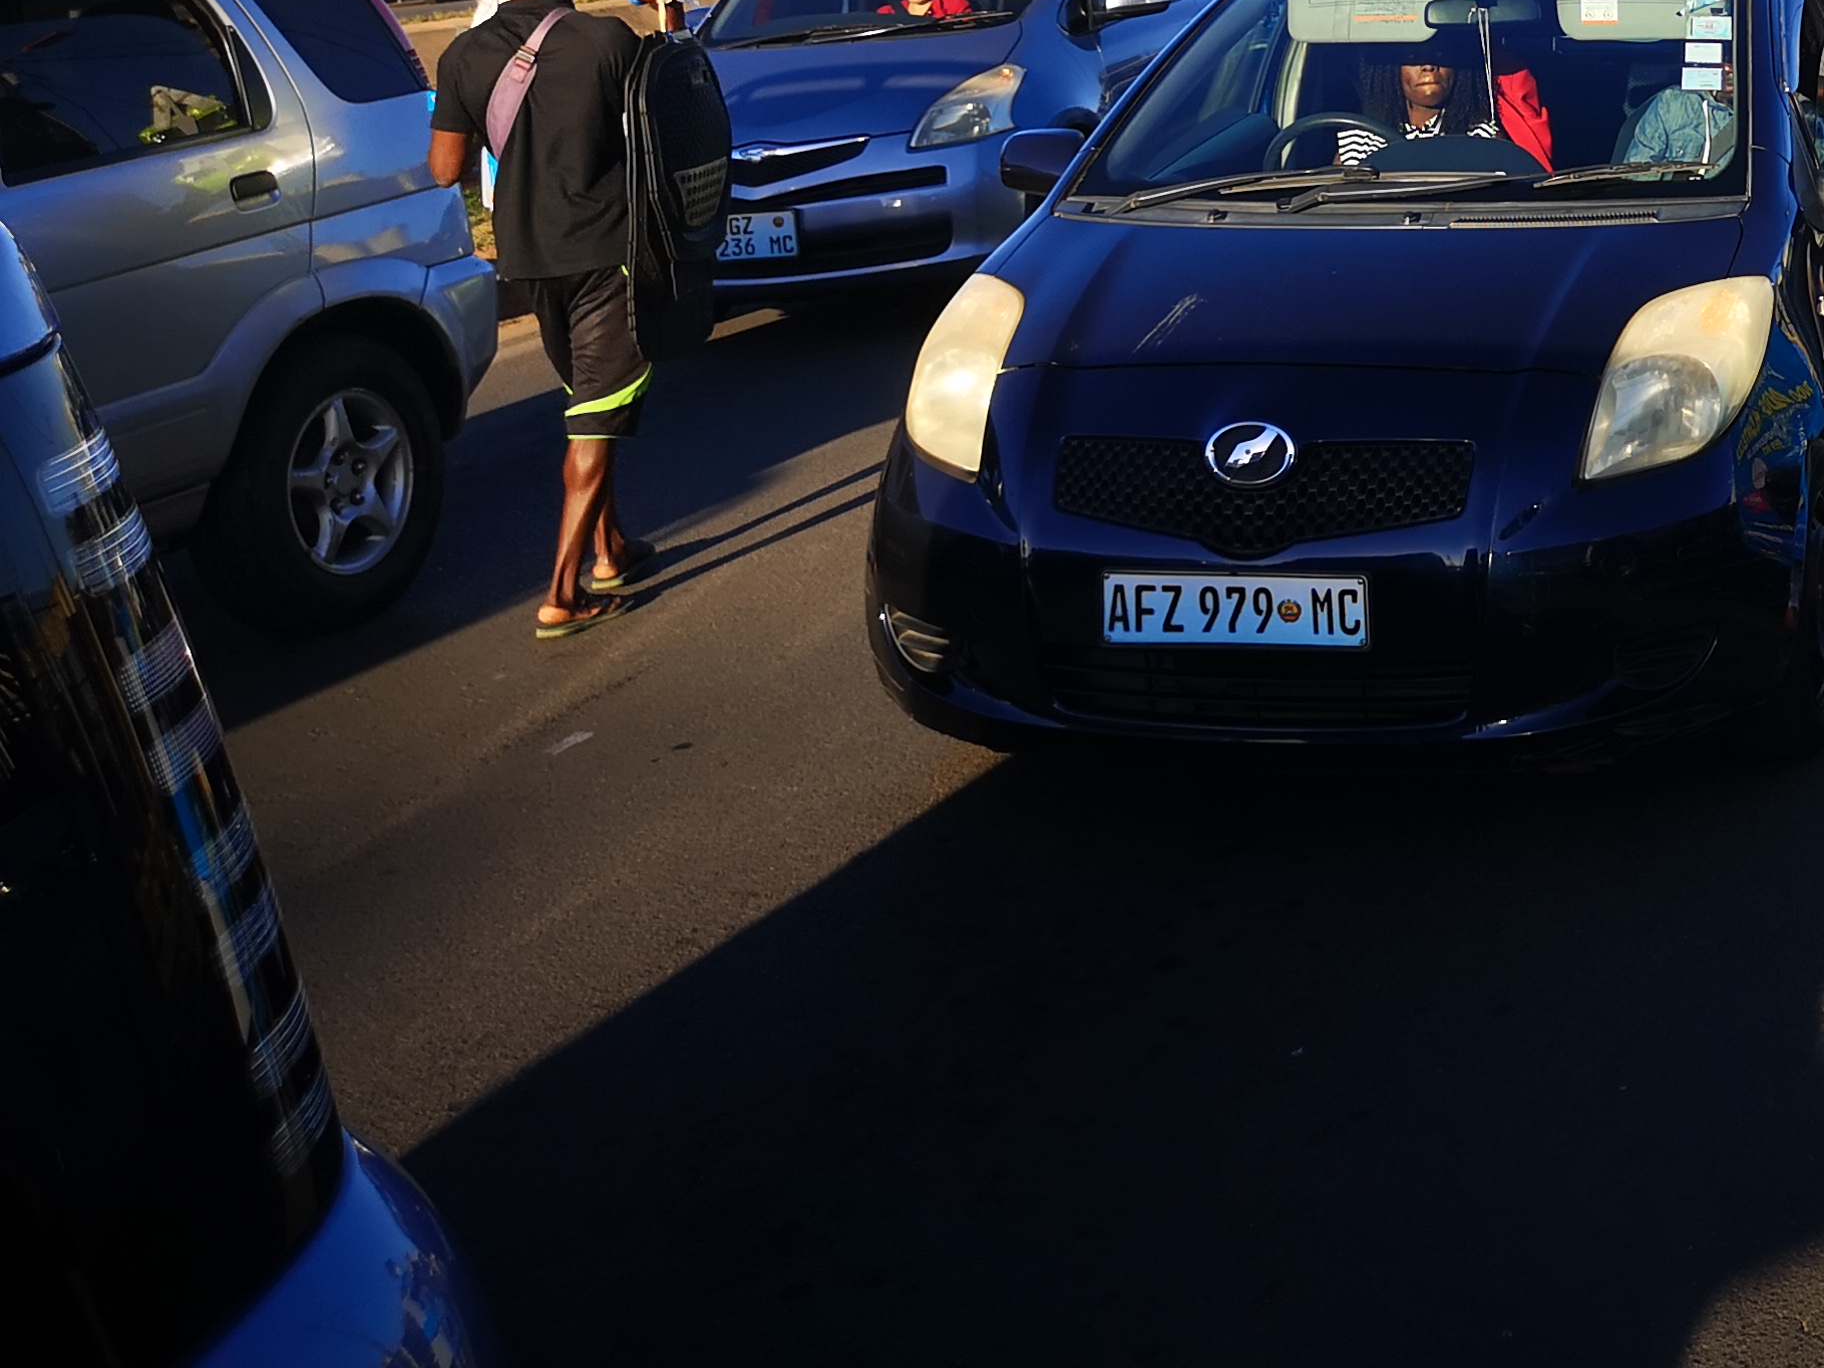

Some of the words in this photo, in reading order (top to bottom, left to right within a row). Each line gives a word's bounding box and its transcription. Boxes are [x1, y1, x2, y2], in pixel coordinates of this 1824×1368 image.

[720, 236, 756, 257] 236
[769, 235, 794, 254] MC
[1107, 583, 1185, 633] AFZ
[1199, 585, 1274, 633] 979
[1311, 587, 1361, 635] MC
